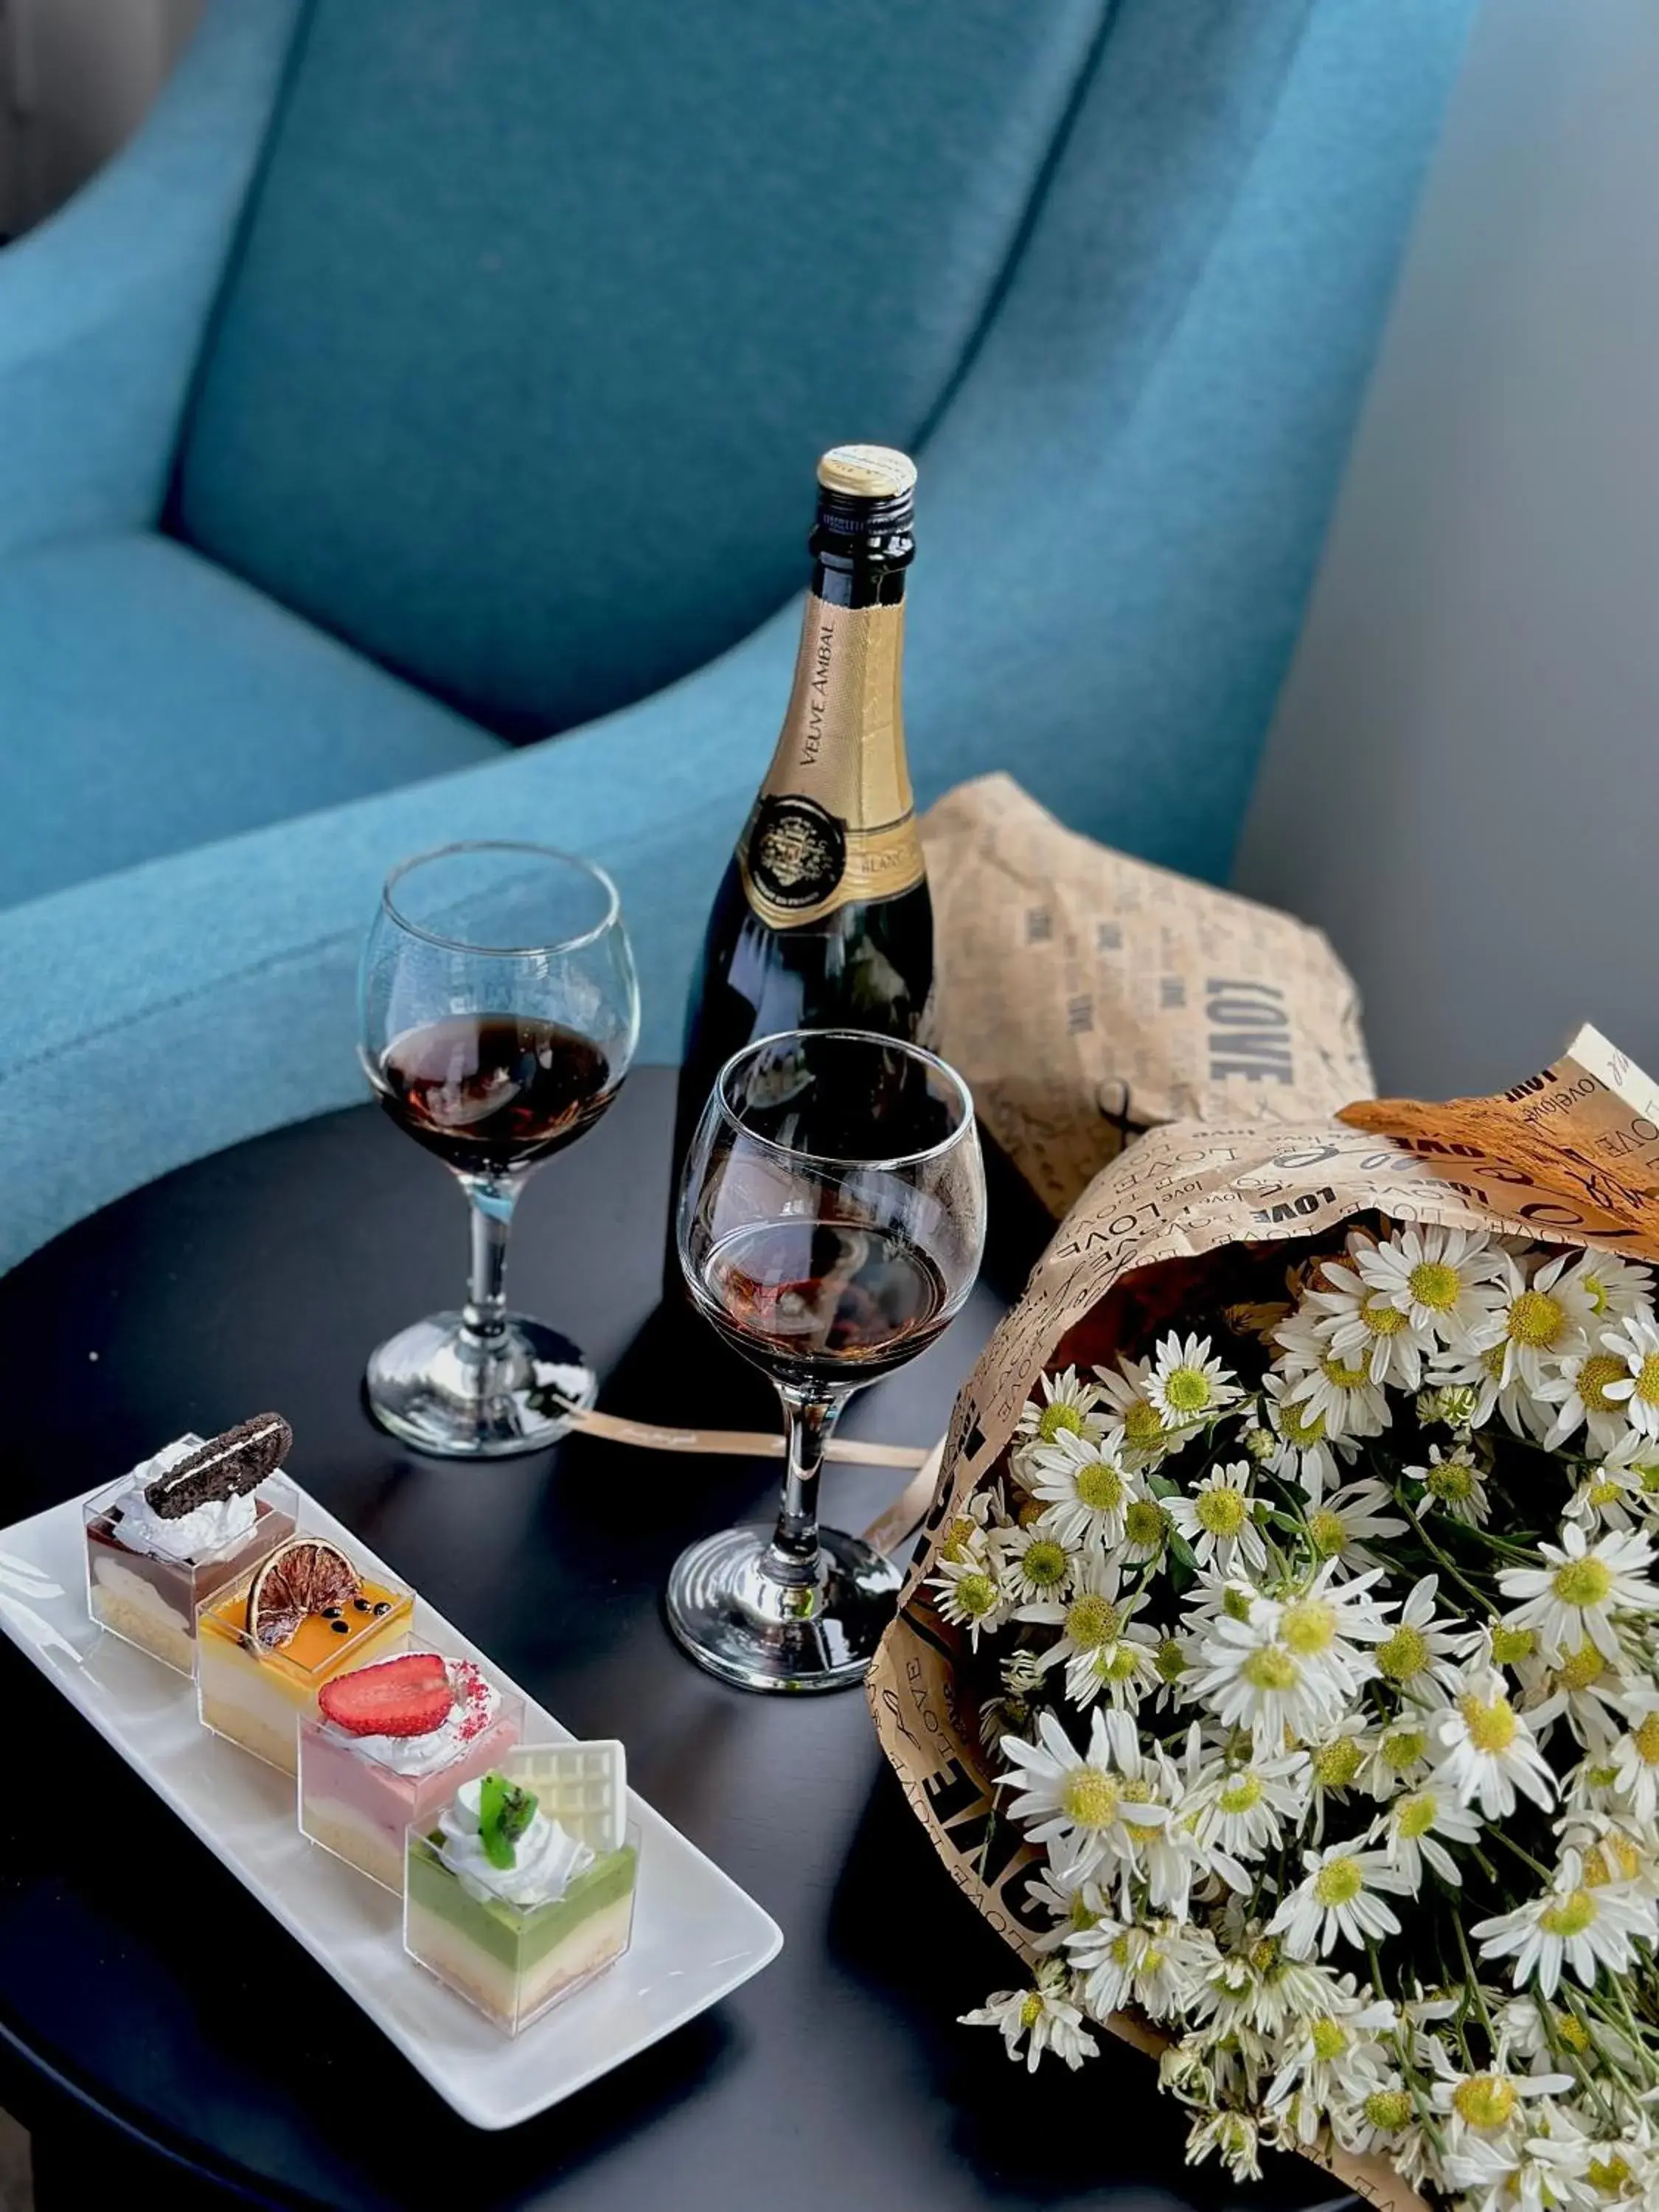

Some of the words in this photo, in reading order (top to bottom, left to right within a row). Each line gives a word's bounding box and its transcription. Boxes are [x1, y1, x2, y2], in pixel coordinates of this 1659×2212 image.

[812, 625, 835, 696] AMBAL
[800, 699, 826, 766] VEUVE
[1206, 975, 1294, 1085] LOVE
[1115, 1147, 1238, 1194] LOVE
[1161, 1180, 1203, 1202] love
[1249, 1186, 1336, 1223] LOVE
[1057, 1203, 1161, 1259] LOVE
[906, 1658, 956, 1759] LOVE
[889, 1752, 945, 1846] LOVE
[953, 1864, 1025, 1952] LOVE
